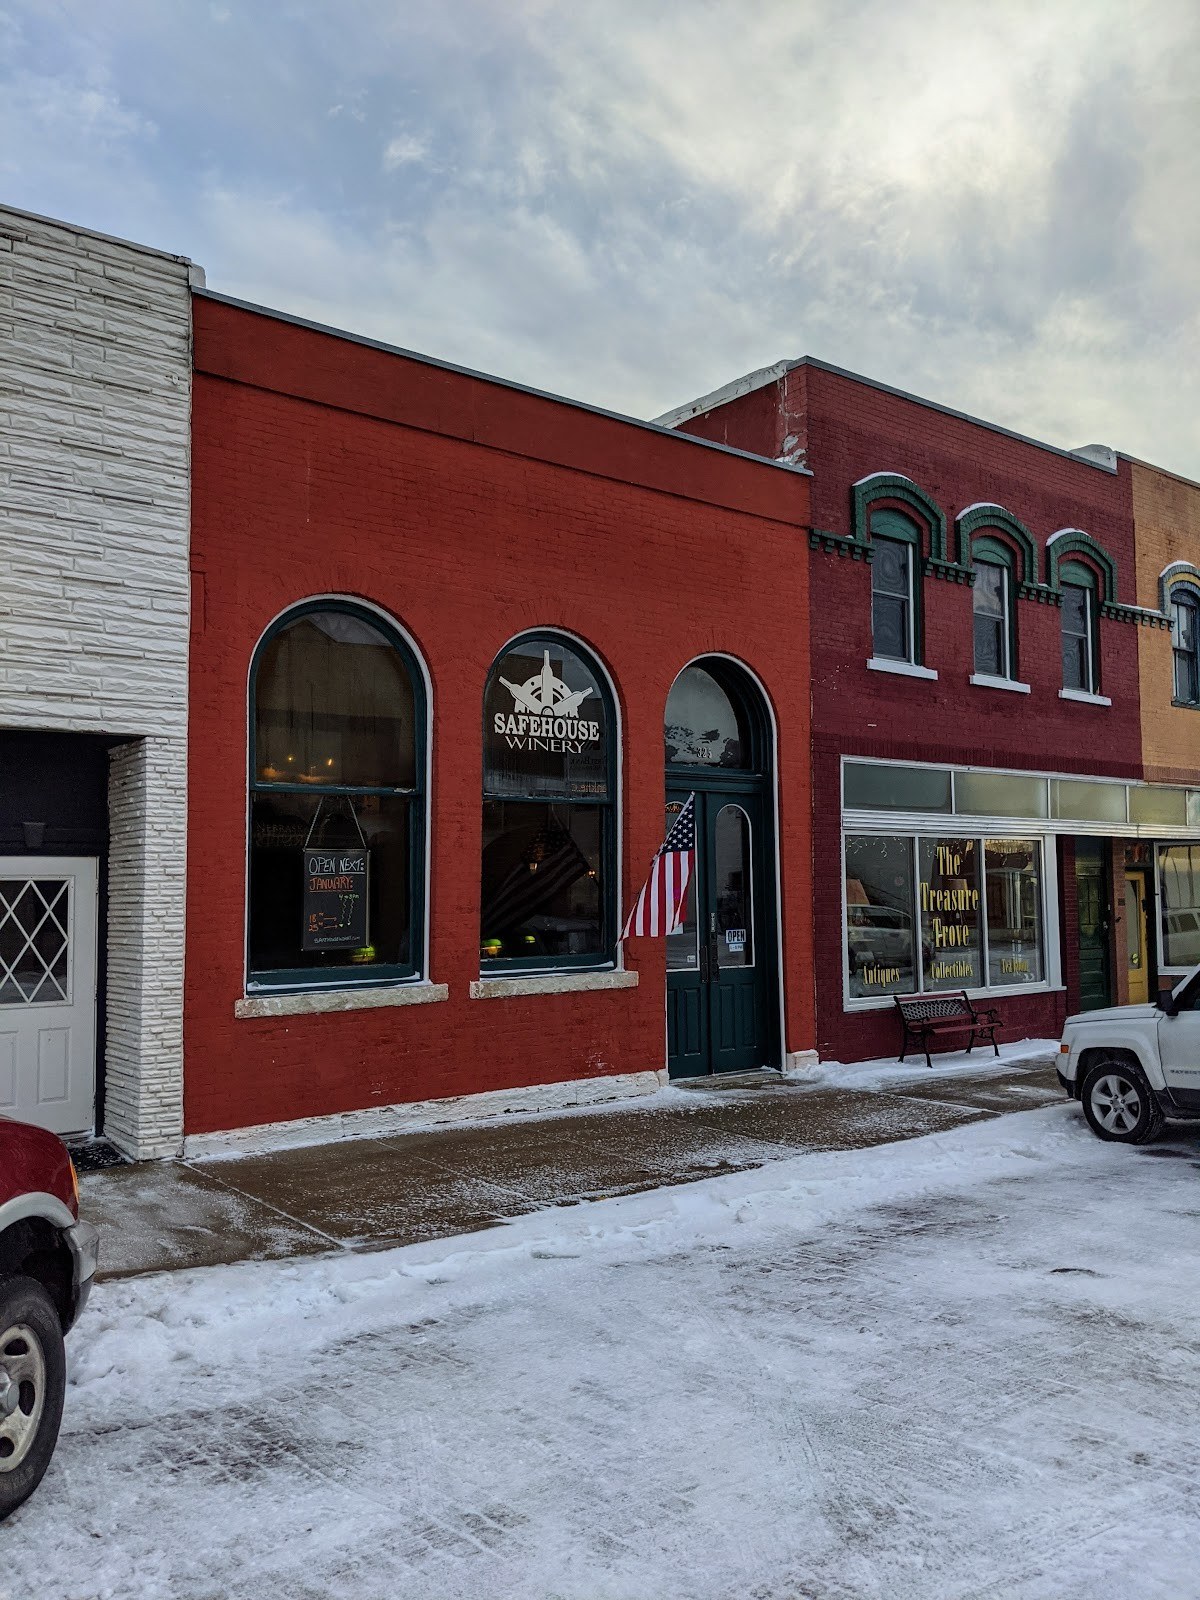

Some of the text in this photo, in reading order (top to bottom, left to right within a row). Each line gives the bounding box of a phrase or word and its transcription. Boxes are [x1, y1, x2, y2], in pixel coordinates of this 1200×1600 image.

[494, 713, 600, 741] SAFEHOUSE
[505, 736, 585, 754] WINERY
[309, 856, 365, 874] OPEN NEXT:
[936, 846, 961, 876] The
[309, 875, 353, 891] JANUARY:
[920, 882, 979, 911] Treasure
[728, 930, 745, 942] OPEN
[932, 918, 970, 948] Trove
[863, 963, 900, 987] Antiques
[931, 961, 973, 979] Collectibles
